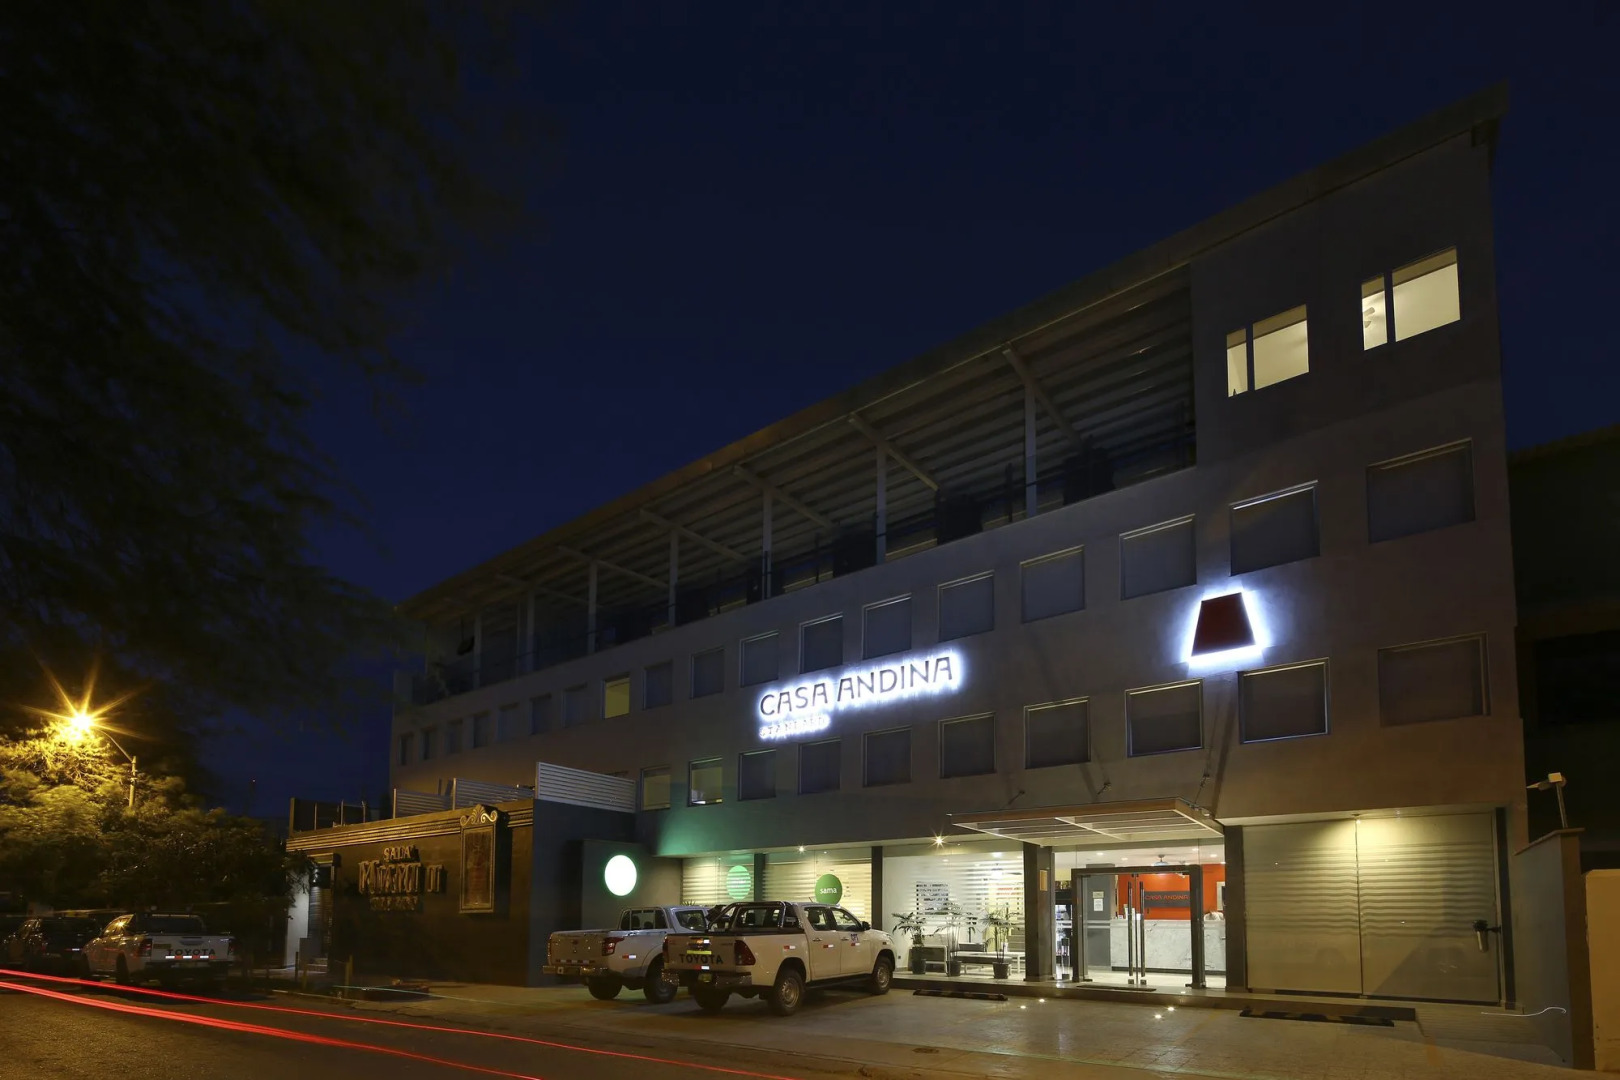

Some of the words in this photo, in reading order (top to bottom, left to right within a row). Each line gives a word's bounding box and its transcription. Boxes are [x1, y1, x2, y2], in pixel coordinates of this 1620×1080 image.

[759, 682, 829, 716] CASA
[836, 656, 953, 703] ANDINA
[383, 845, 412, 862] SALA
[819, 887, 838, 895] sama
[166, 948, 216, 957] TOYOTA
[679, 953, 723, 965] TOYOTA
